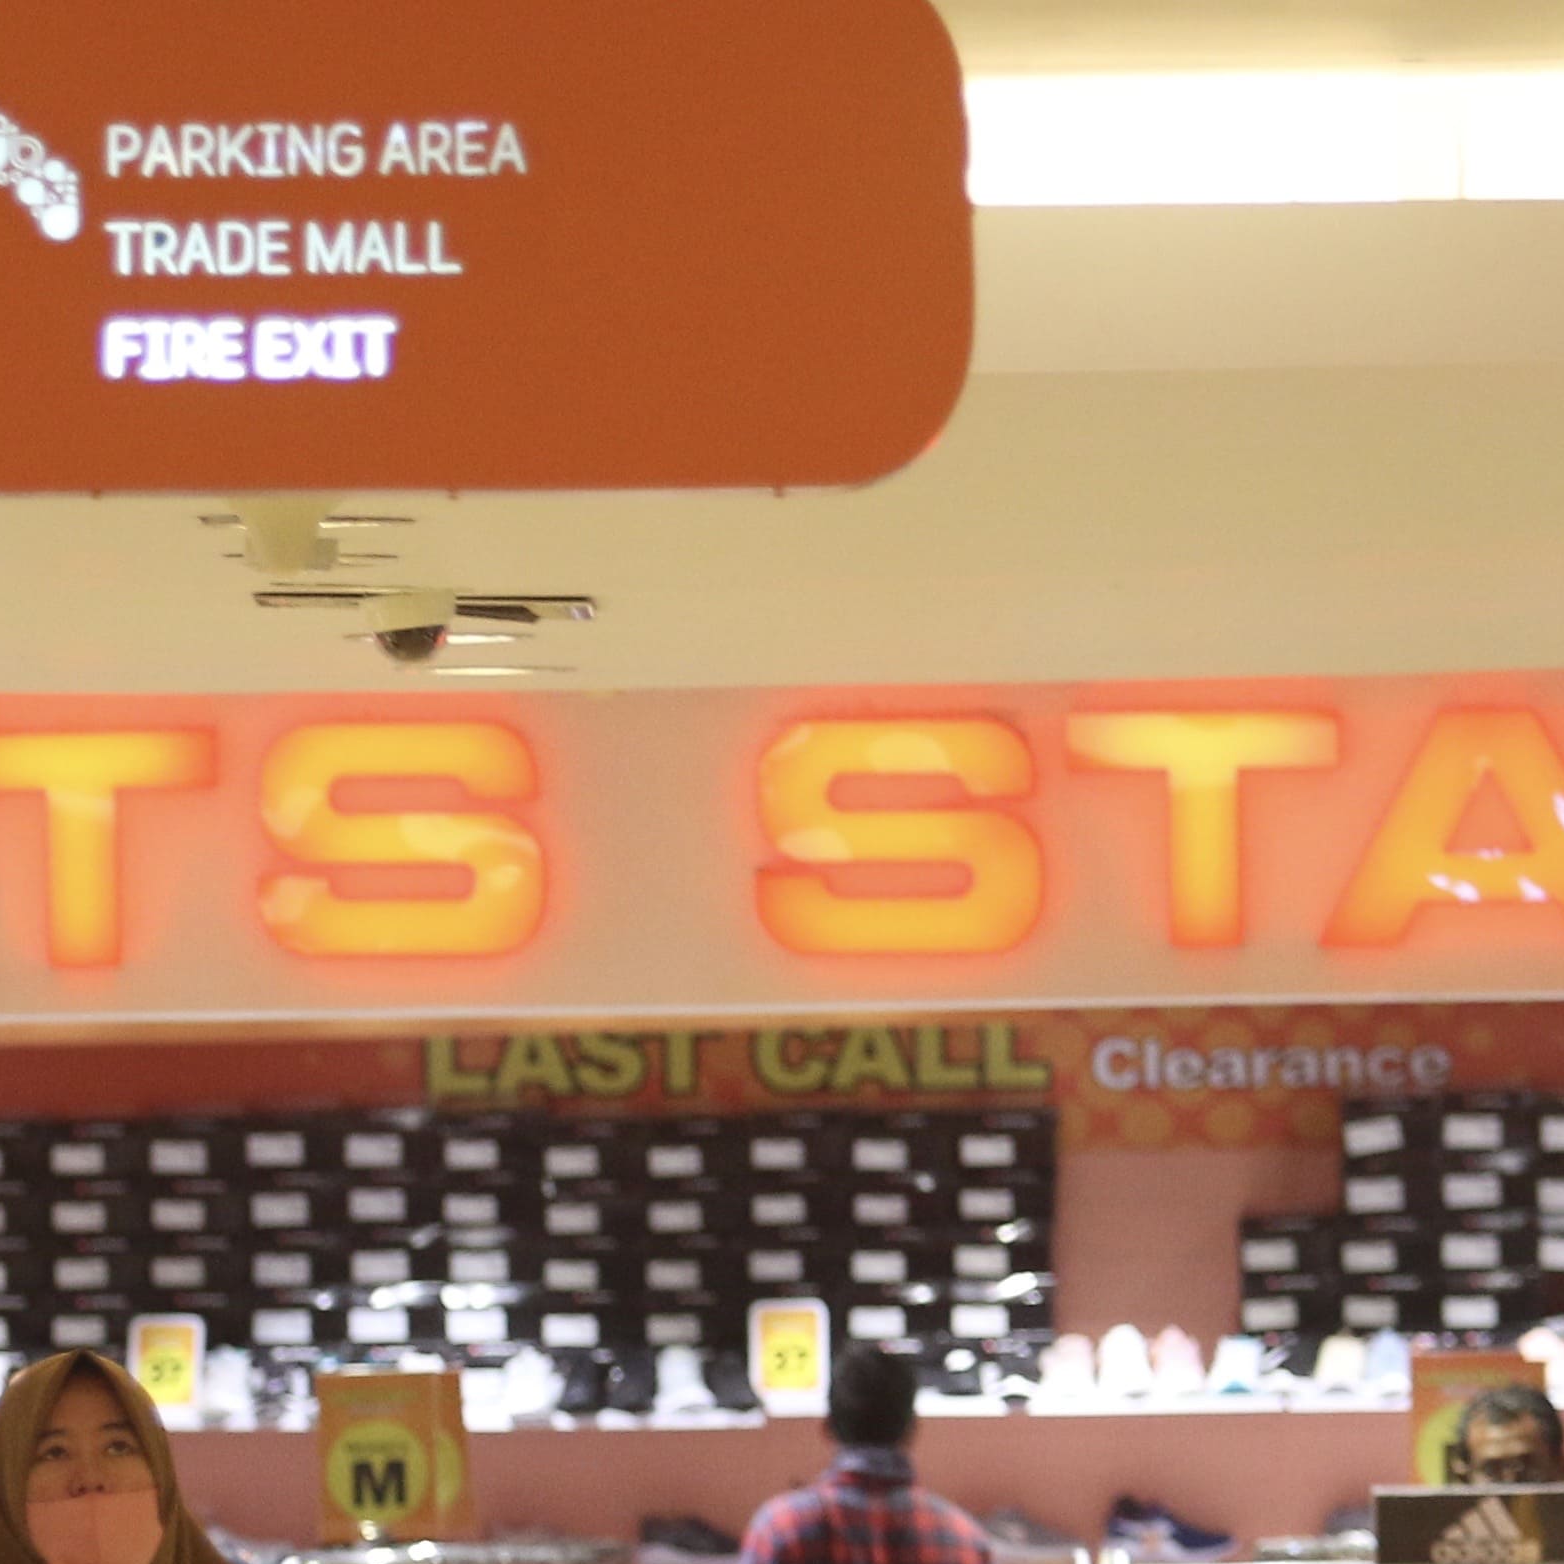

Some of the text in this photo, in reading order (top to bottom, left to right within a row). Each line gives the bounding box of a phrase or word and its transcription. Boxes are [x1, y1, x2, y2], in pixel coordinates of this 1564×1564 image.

[105, 119, 528, 178] PARKING AREA
[104, 220, 464, 276] TRADE MALL
[101, 316, 399, 380] FIRE EXIT
[423, 1022, 1050, 1097] LAST CALL
[1090, 1035, 1452, 1092] Clearance
